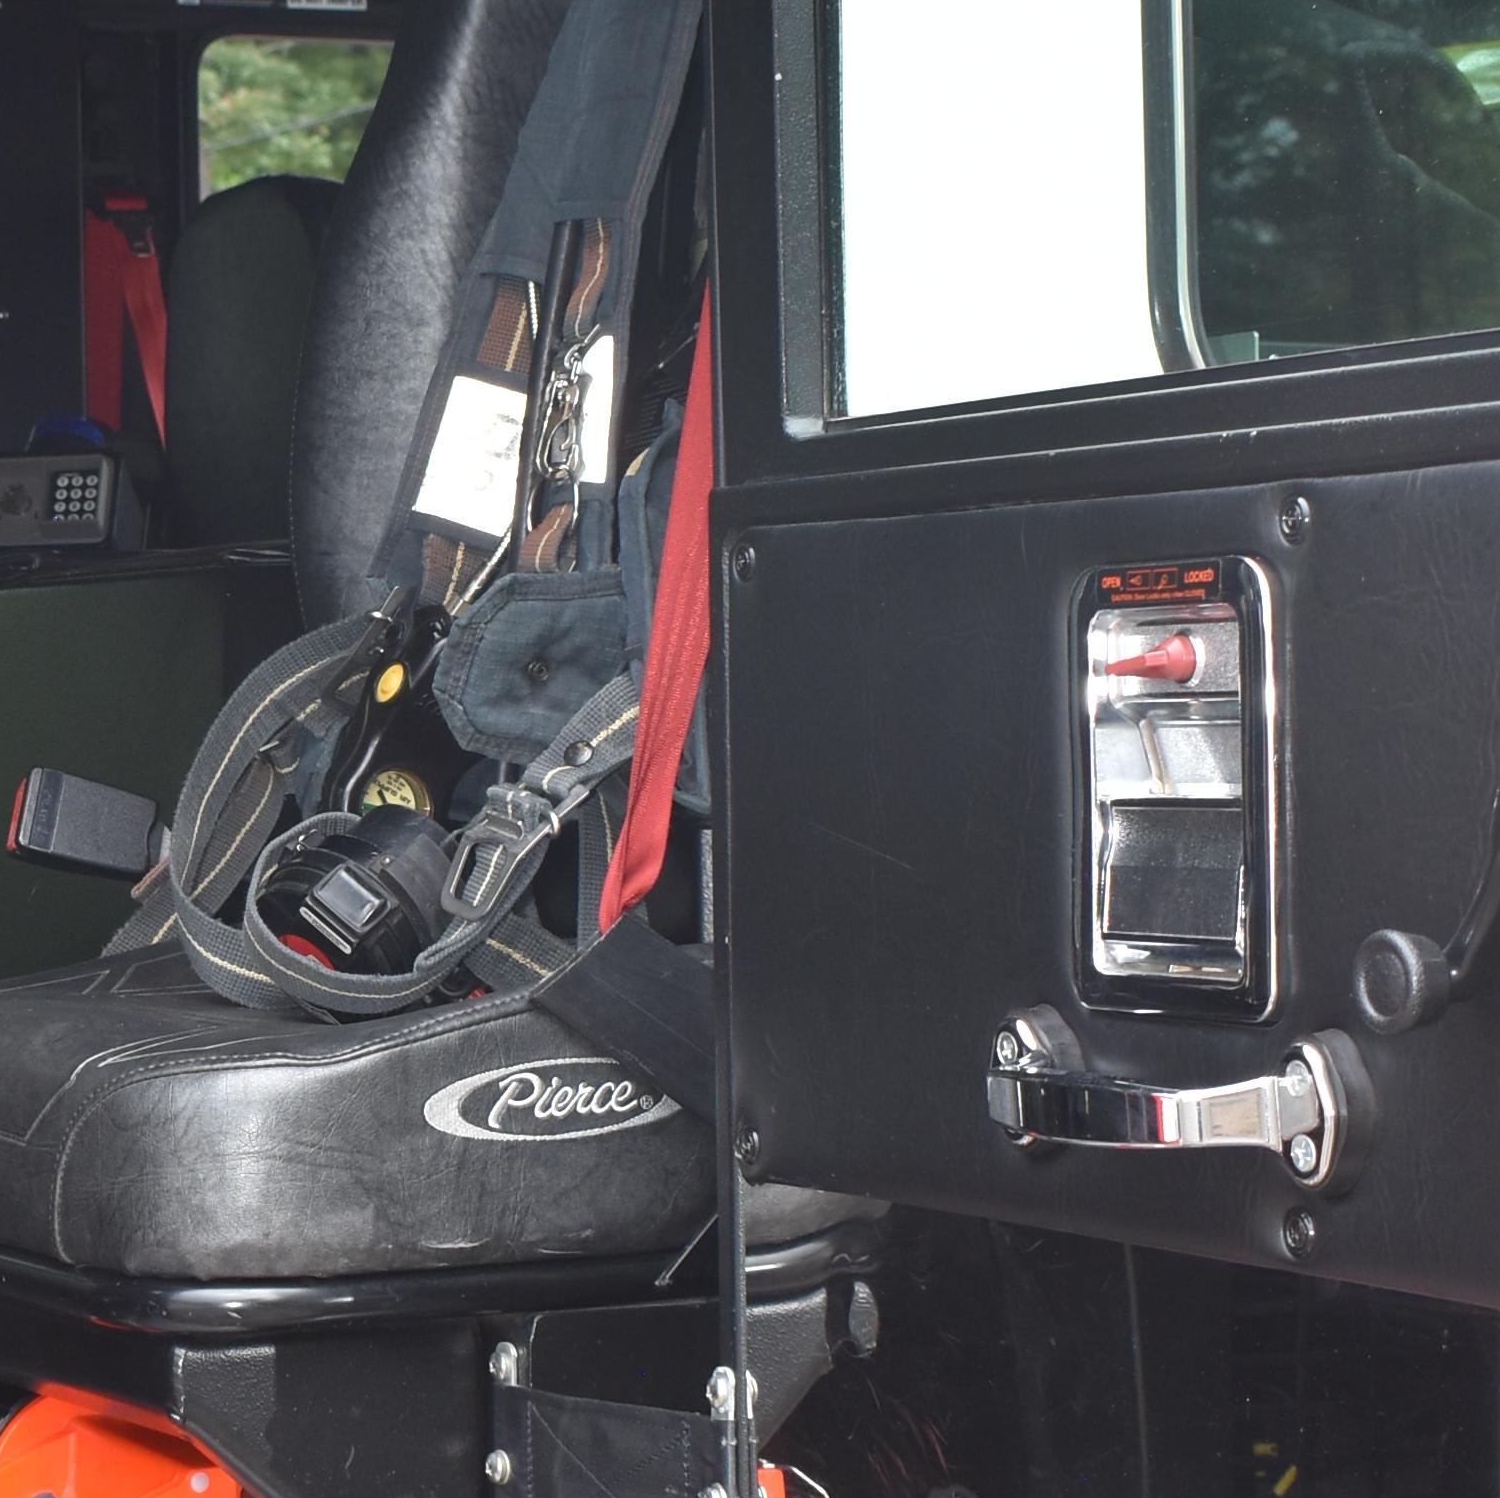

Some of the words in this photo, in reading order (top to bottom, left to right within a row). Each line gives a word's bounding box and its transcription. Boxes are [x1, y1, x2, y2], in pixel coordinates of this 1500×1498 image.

[1101, 576, 1122, 589] OPEN
[1183, 568, 1215, 584] LOCKED
[488, 1072, 638, 1129] Pierce
